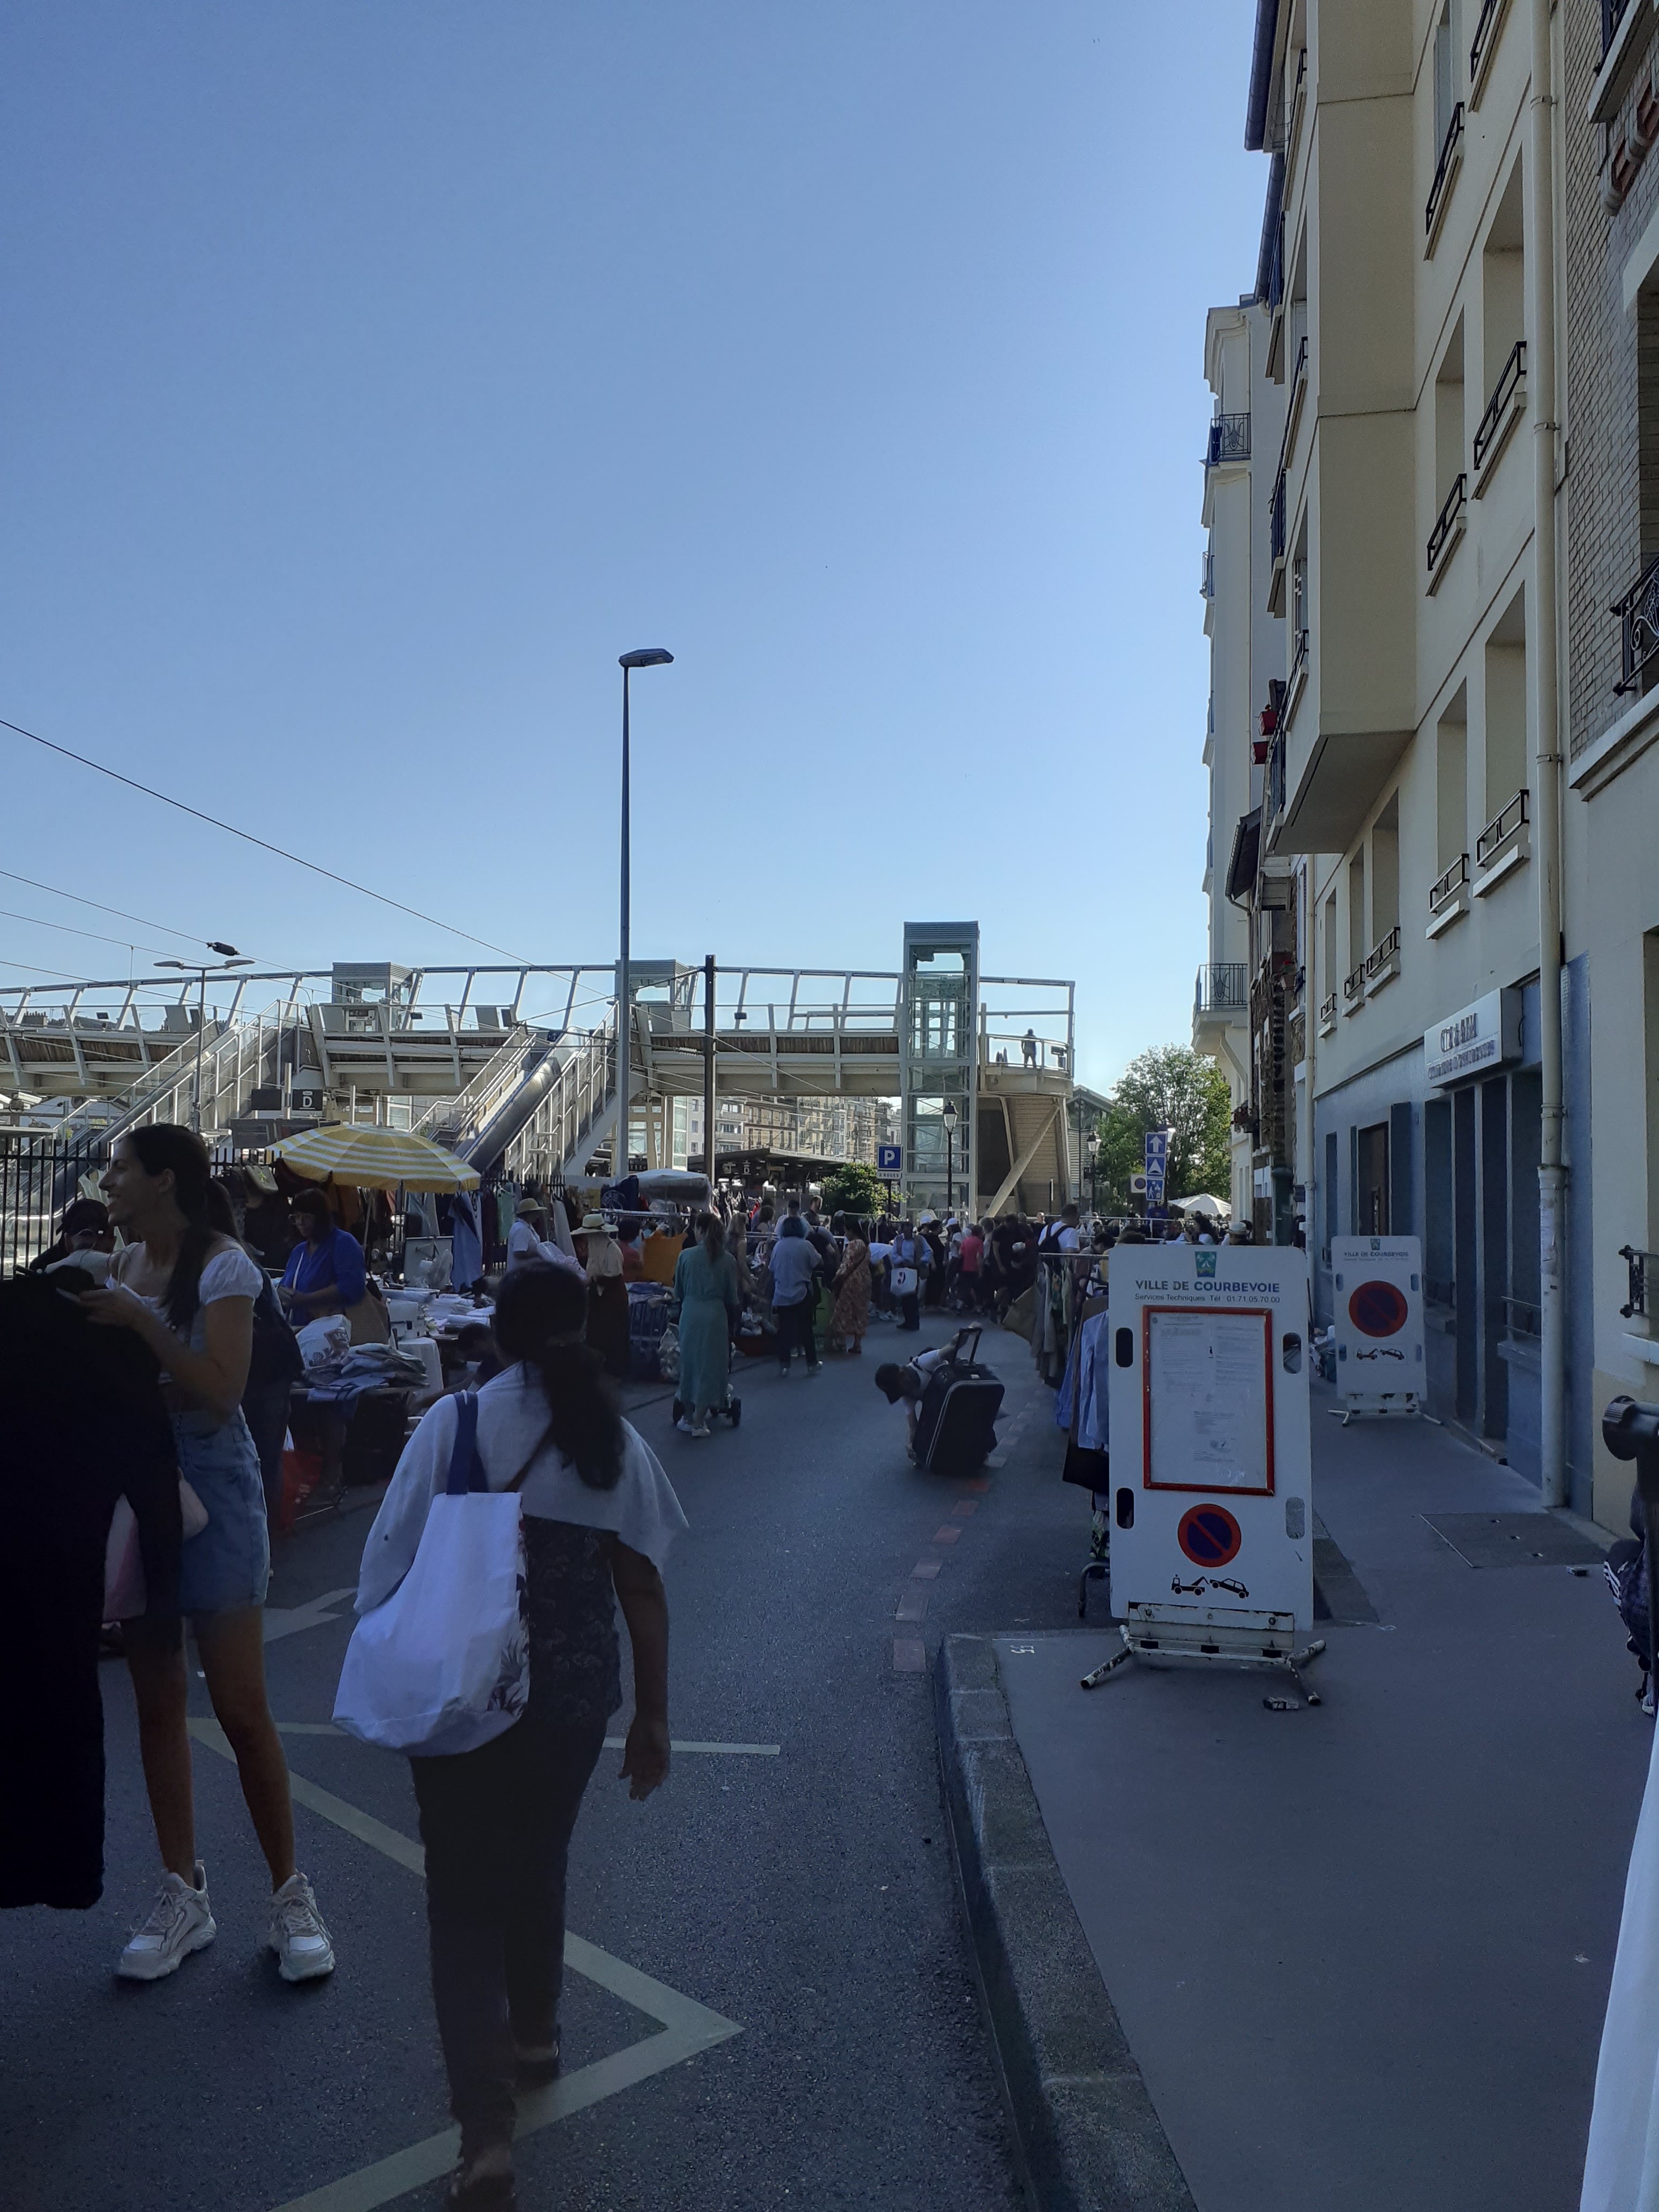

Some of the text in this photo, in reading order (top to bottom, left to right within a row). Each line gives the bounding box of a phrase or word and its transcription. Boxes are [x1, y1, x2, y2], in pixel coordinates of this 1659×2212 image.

[303, 1096, 312, 1108] D
[884, 1149, 895, 1165] P
[1135, 1280, 1280, 1292] VILLE DE COURBEVOIE
[1167, 1294, 1205, 1302] Techniques
